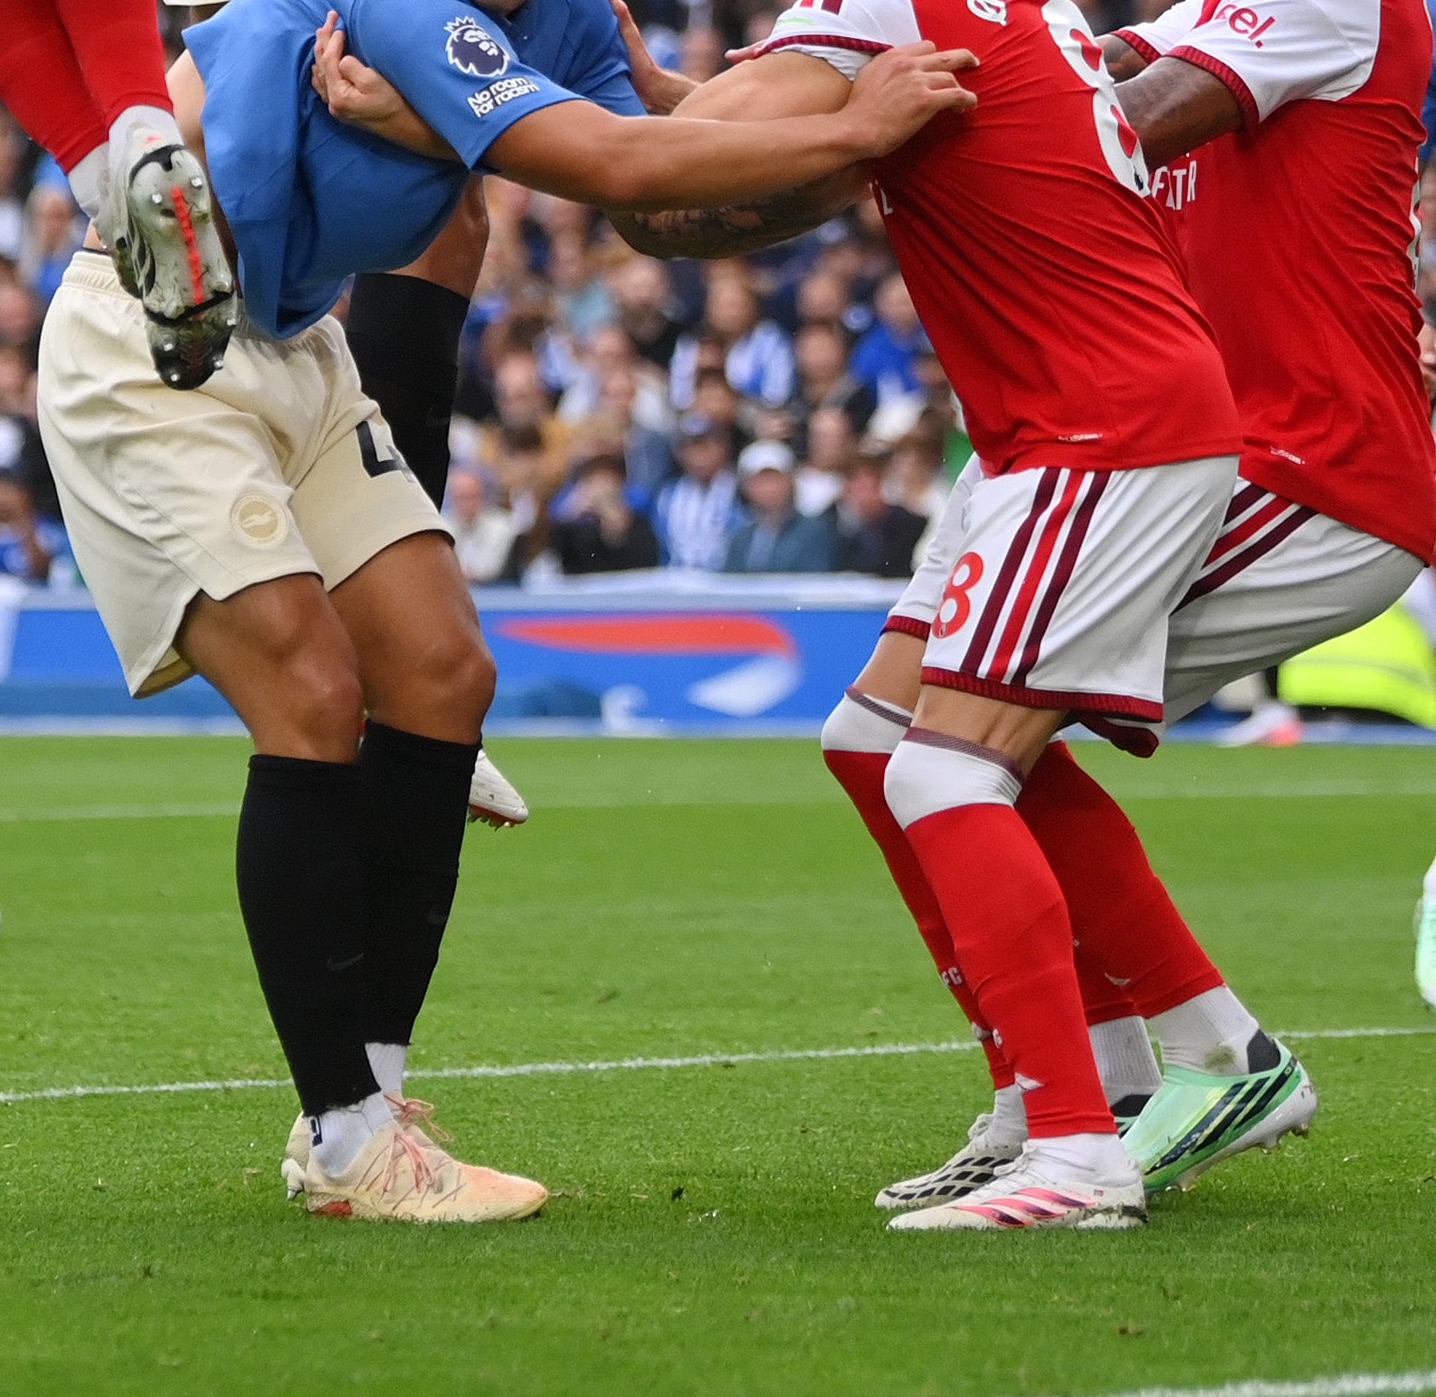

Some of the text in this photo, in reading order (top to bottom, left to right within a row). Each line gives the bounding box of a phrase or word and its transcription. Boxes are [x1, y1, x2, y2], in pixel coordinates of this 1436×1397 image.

[467, 77, 527, 106] No room
[931, 551, 984, 639] 8
